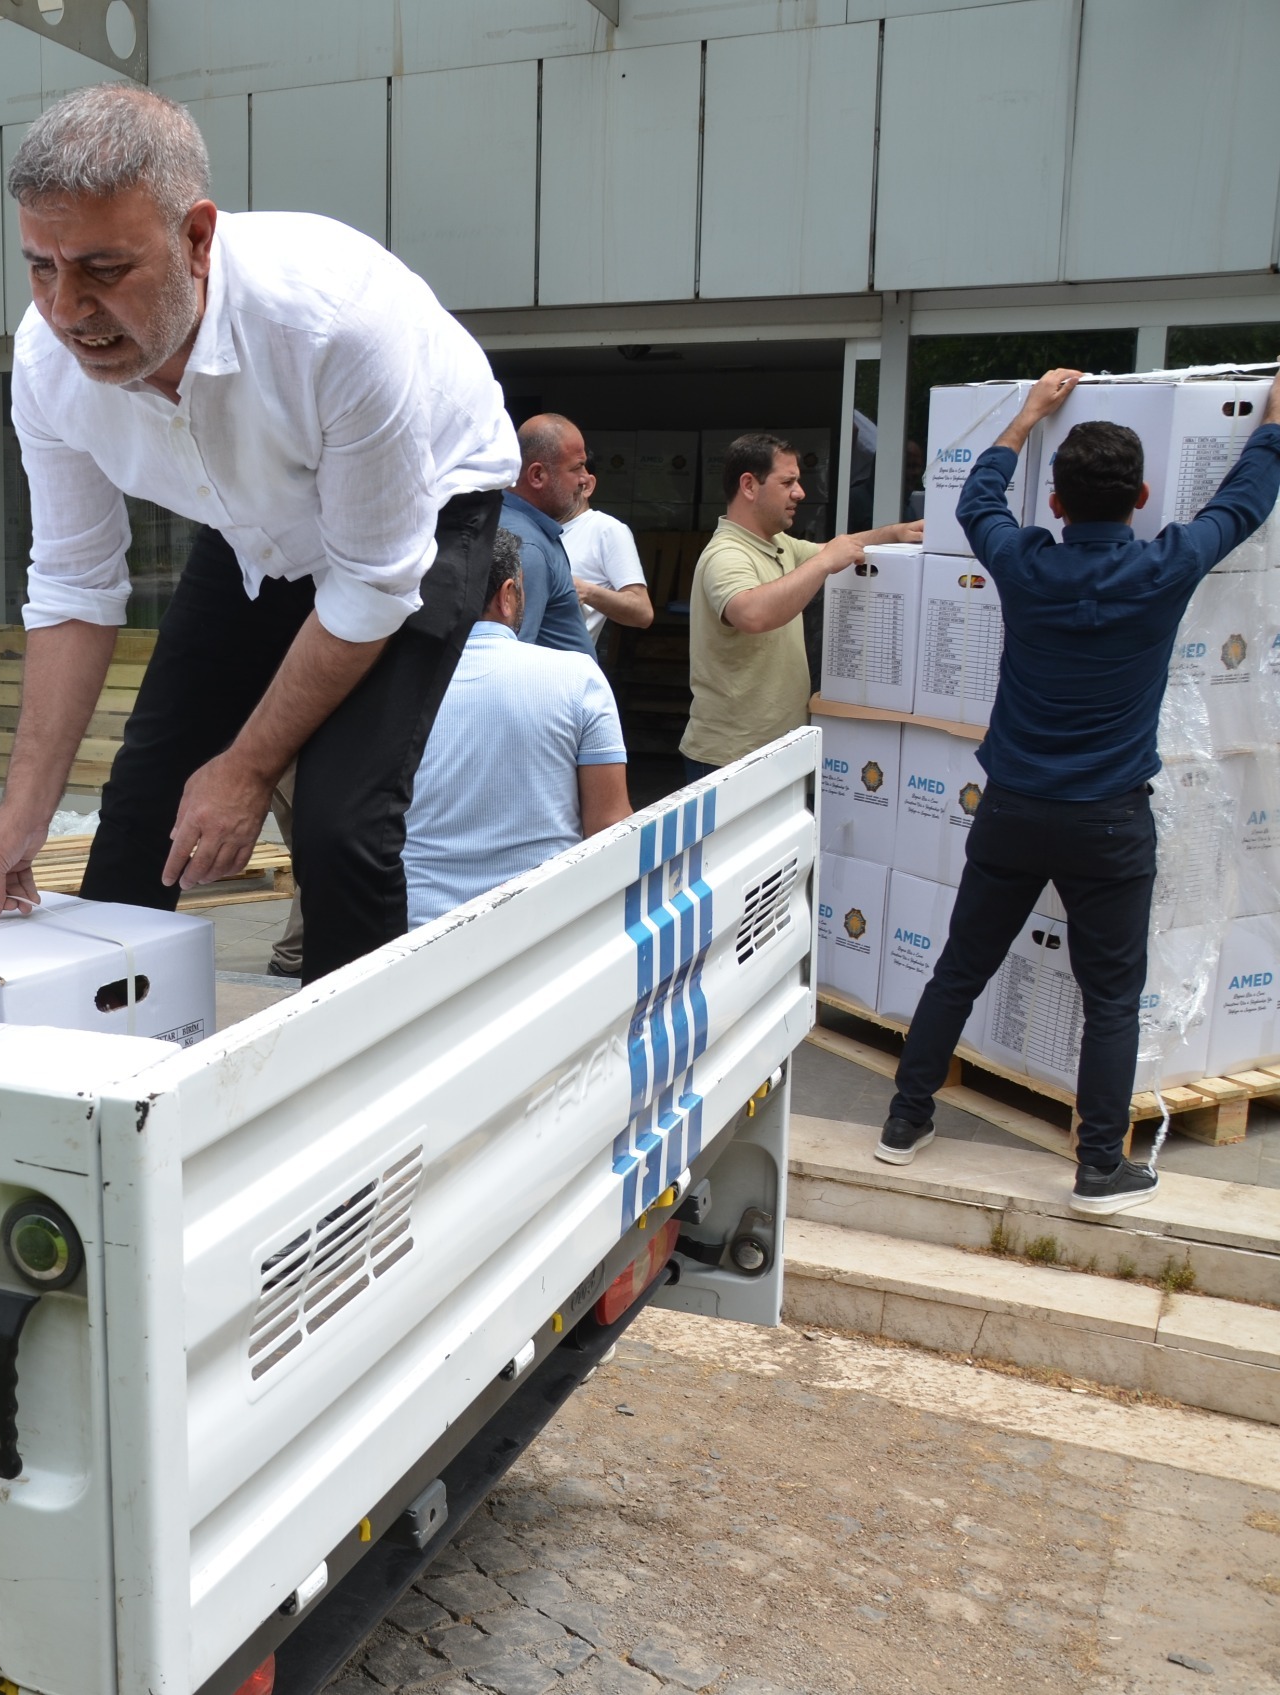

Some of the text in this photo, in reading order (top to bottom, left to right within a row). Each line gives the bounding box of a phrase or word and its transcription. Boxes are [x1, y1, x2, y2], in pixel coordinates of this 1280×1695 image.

[936, 448, 972, 463] AMED
[822, 757, 849, 774] MED
[907, 775, 945, 795] AMED
[819, 903, 833, 919] ED
[893, 928, 931, 950] AMED
[1228, 972, 1273, 990] AMED
[1139, 993, 1160, 1009] ED
[182, 1023, 199, 1035] BİRİM
[184, 1037, 194, 1046] KG
